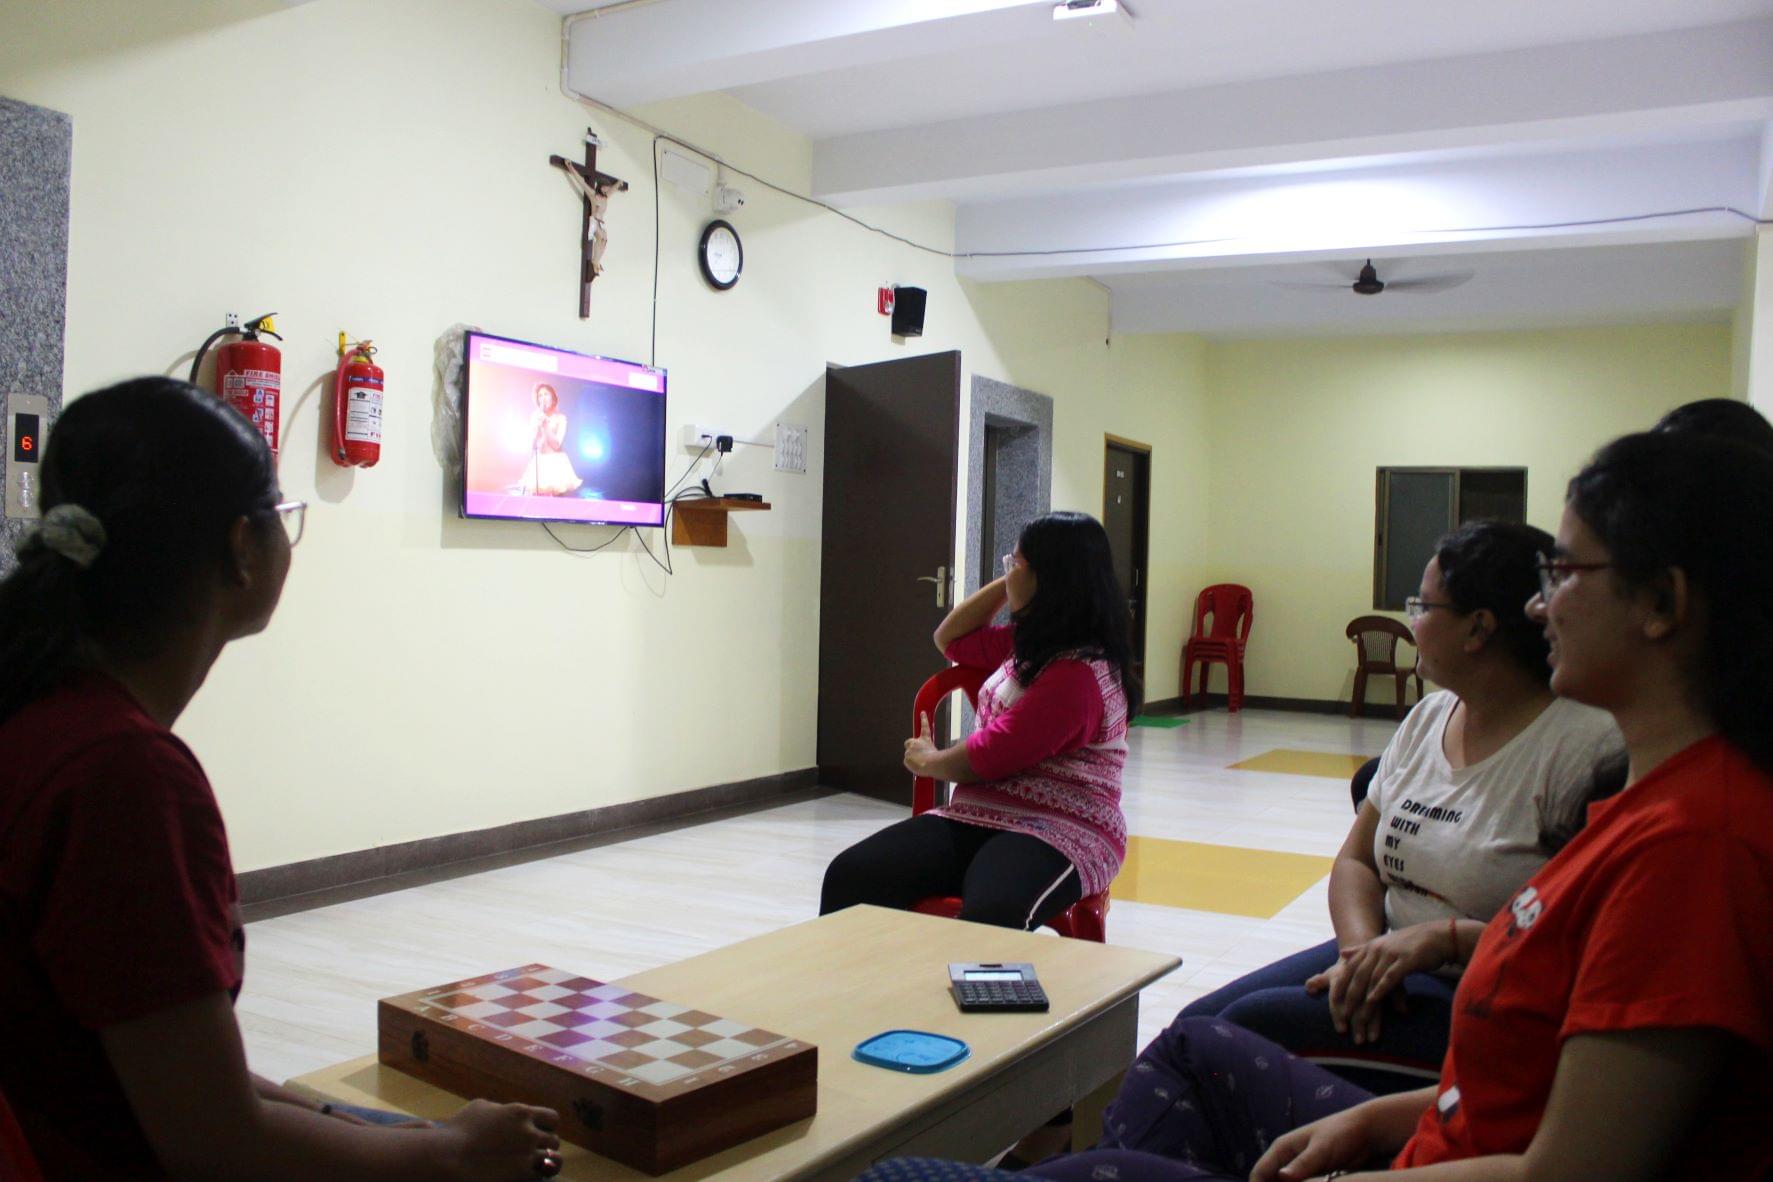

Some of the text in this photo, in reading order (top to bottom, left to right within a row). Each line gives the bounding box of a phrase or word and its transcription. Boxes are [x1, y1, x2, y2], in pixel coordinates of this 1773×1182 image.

[21, 435, 33, 450] 6
[1390, 816, 1420, 836] WITH
[1385, 834, 1401, 850] MY
[1383, 853, 1404, 872] EYES
